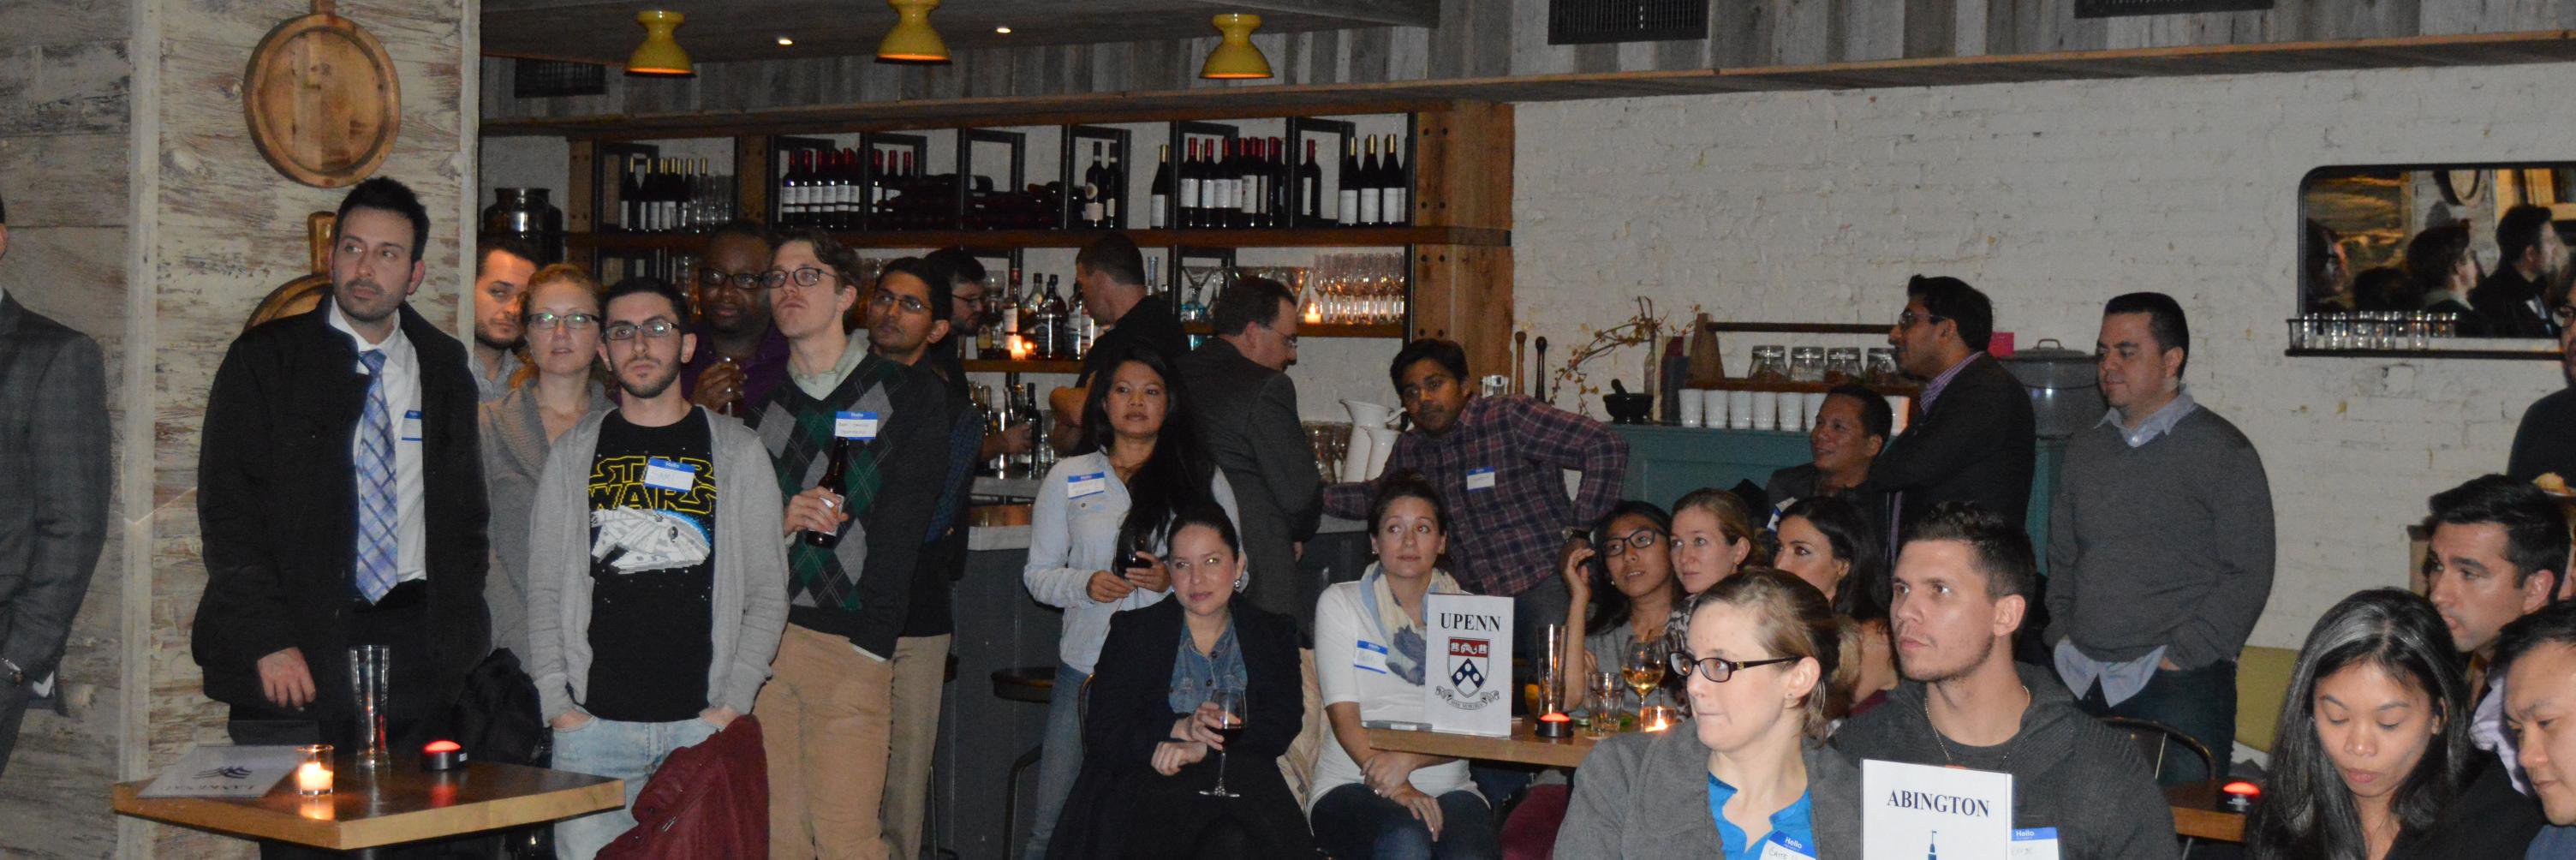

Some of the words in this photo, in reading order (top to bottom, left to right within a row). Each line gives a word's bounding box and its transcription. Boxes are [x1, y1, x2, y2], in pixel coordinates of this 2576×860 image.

[589, 455, 717, 491] STR
[588, 483, 718, 514] WARS
[1440, 612, 1500, 632] UPENN
[1887, 790, 1990, 818] ABINGTON
[1785, 836, 1803, 849] Hello
